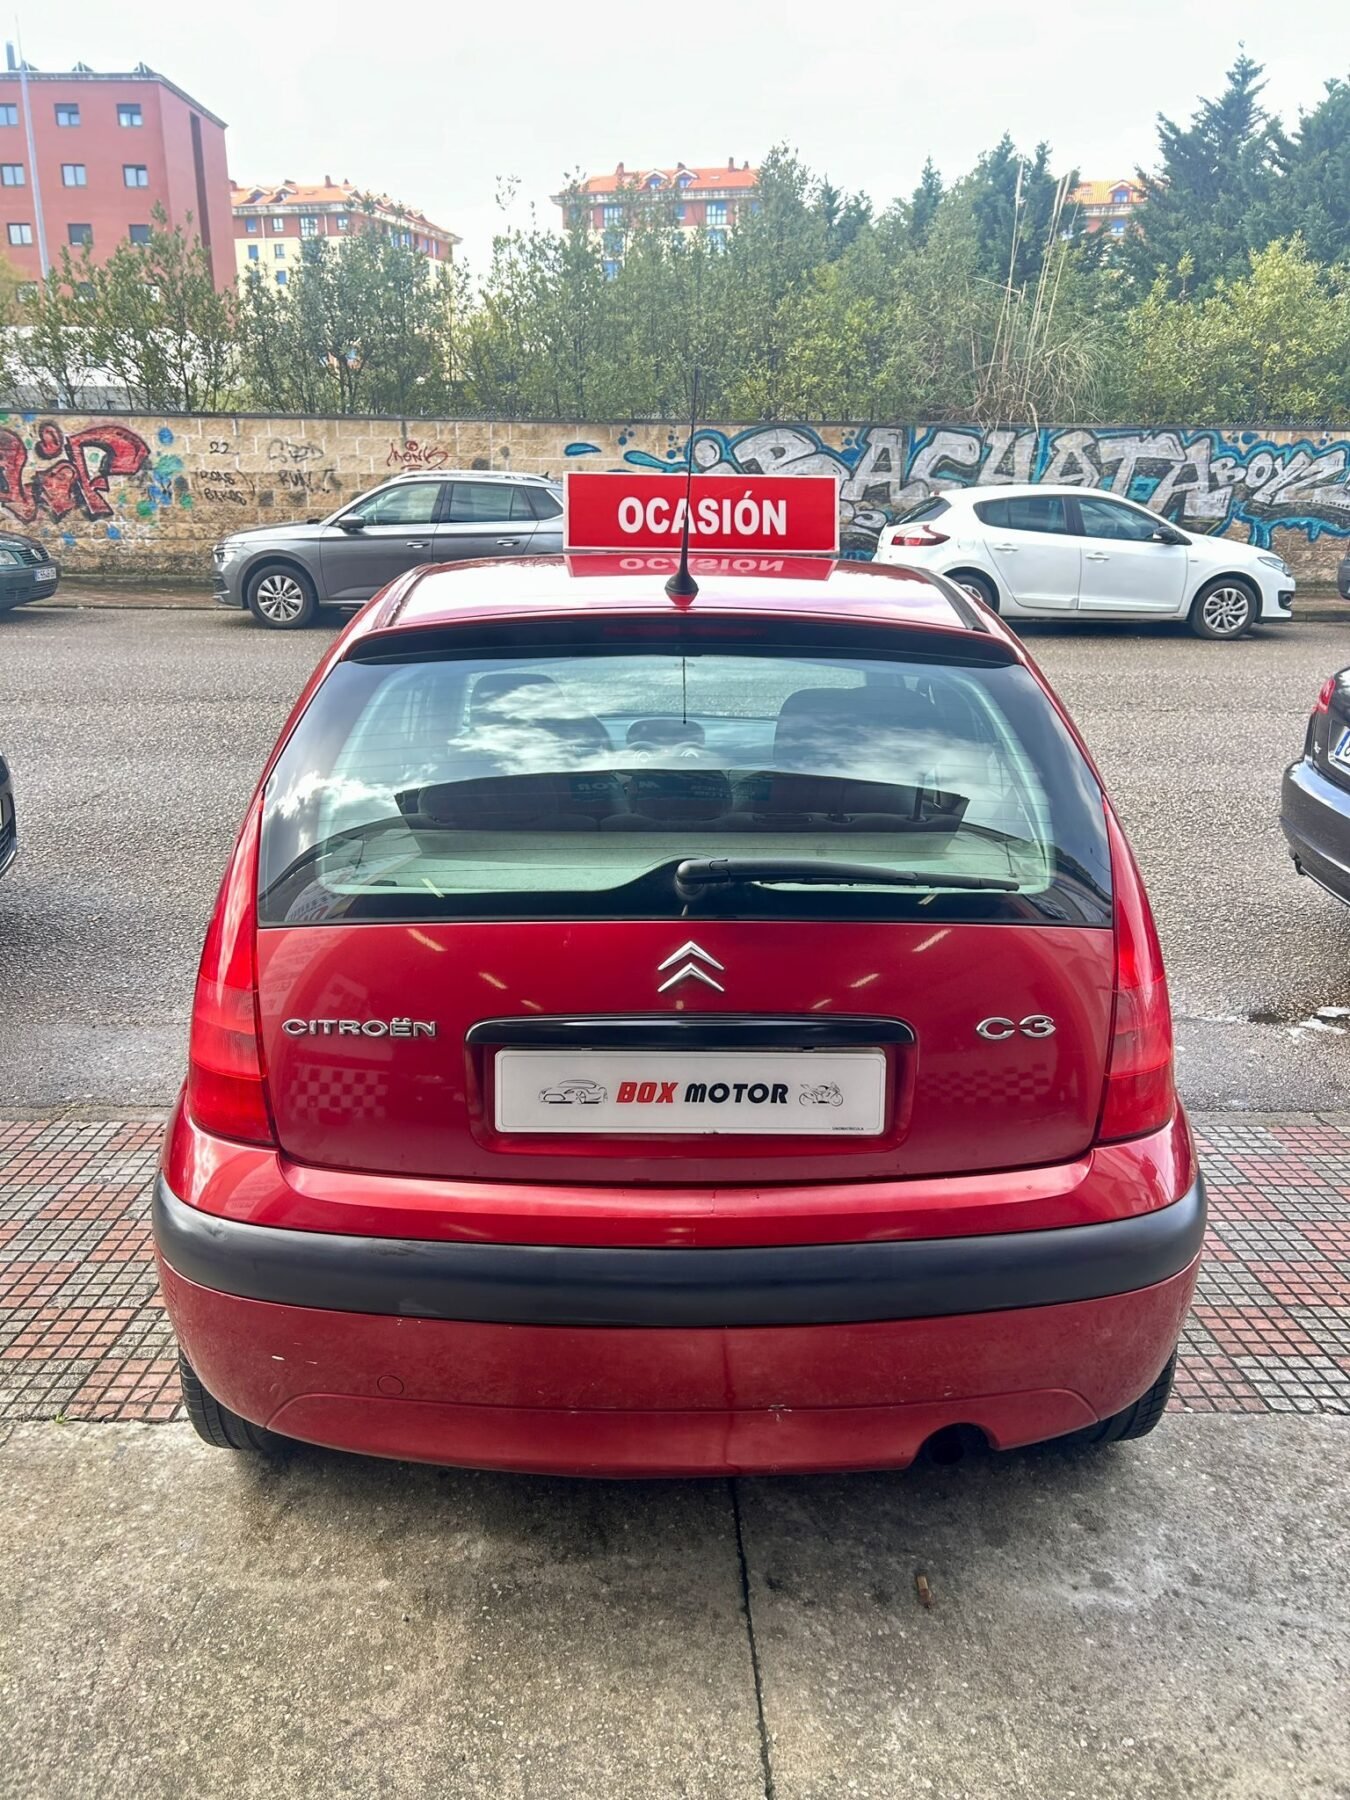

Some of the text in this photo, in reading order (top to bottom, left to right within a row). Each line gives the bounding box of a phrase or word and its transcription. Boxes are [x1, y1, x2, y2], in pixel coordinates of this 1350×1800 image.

[618, 490, 787, 535] OCASIÓN
[282, 1017, 437, 1037] CITROËN
[976, 1014, 1056, 1040] C3
[616, 1081, 789, 1104] BOX MOTOR
